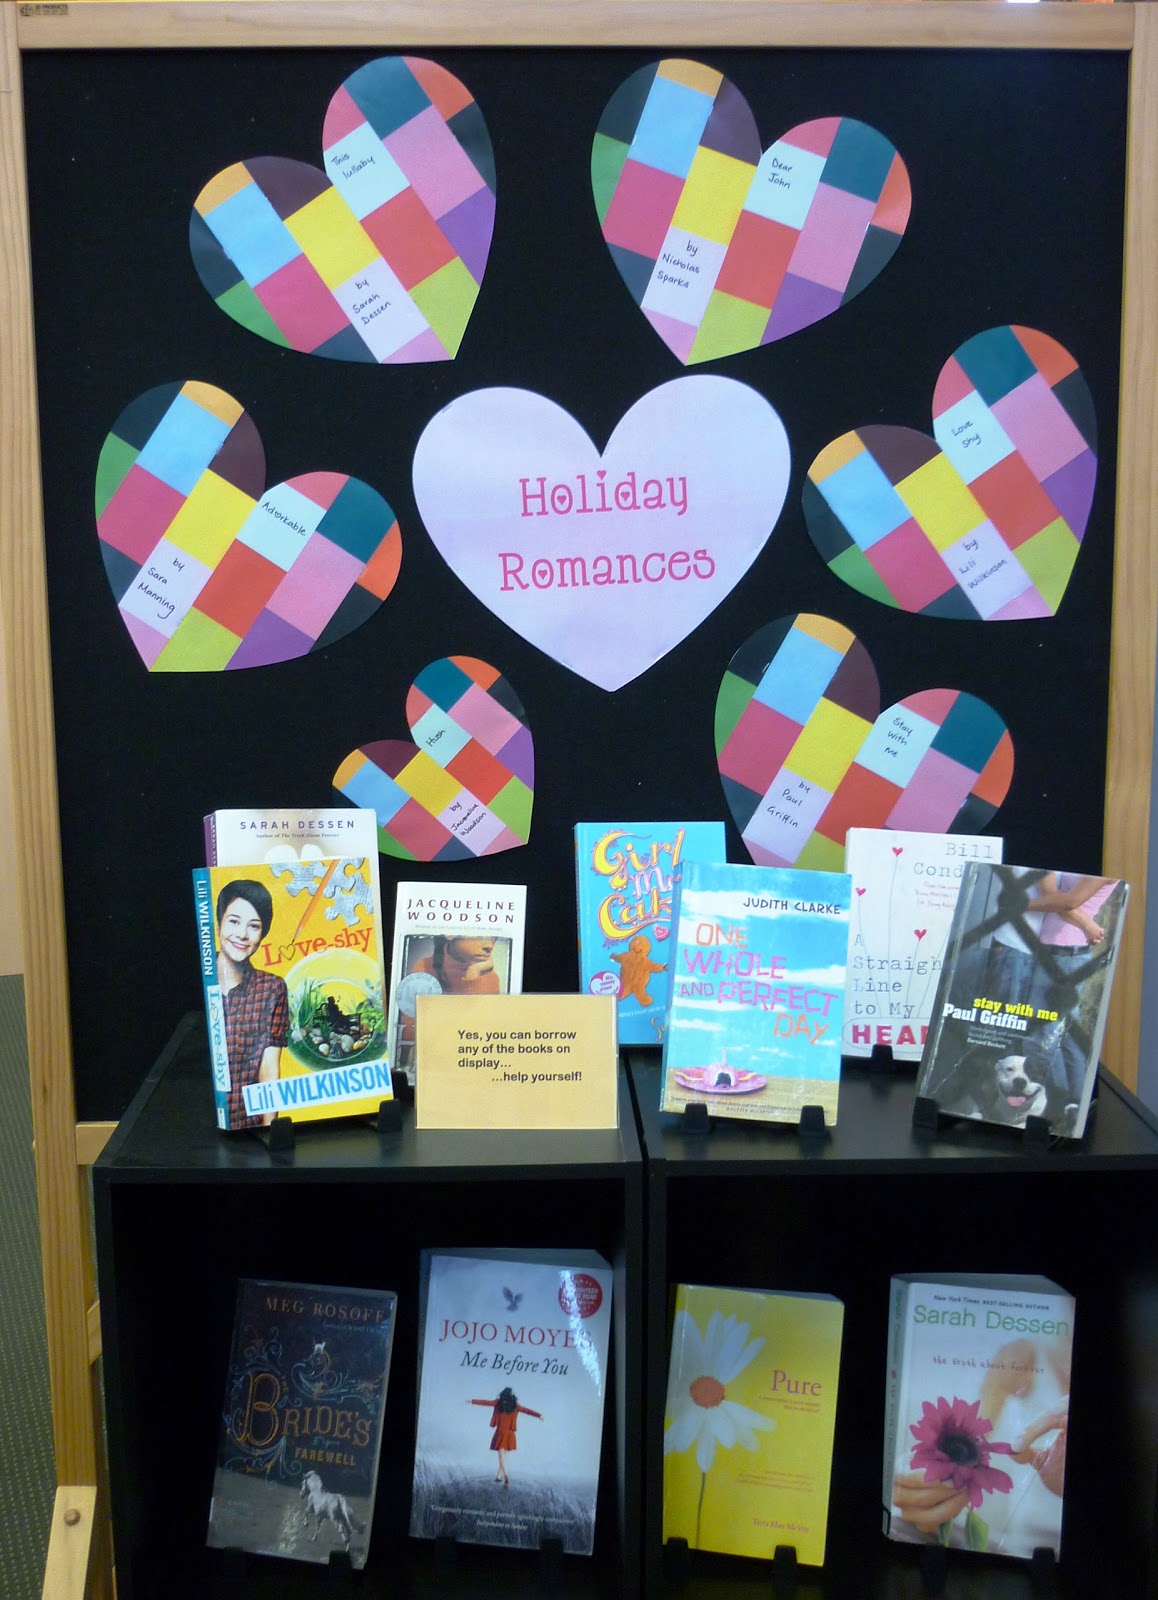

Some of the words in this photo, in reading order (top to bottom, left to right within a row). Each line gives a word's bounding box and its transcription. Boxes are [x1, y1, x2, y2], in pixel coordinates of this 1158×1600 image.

[331, 152, 350, 166] This
[771, 157, 793, 172] Dear
[768, 172, 791, 189] John
[686, 240, 699, 257] by
[662, 253, 700, 274] Nicholas
[355, 278, 369, 290] by
[657, 271, 690, 289] Sparks
[352, 294, 380, 314] Sarah
[361, 301, 391, 326] Dessen
[952, 420, 973, 437] Love
[519, 470, 688, 517] Holiday
[261, 502, 306, 536] Adorkable
[963, 538, 979, 552] by
[172, 558, 186, 571] by
[498, 549, 716, 591] Romances
[959, 559, 977, 575] Lili
[968, 559, 1008, 589] Wilkinson
[148, 567, 168, 584] Sara
[137, 581, 176, 619] Manning
[893, 717, 914, 737] Stay
[887, 730, 908, 746] with
[884, 747, 898, 758] me
[798, 781, 811, 794] by
[450, 802, 463, 812] by
[782, 788, 803, 807] Paul
[240, 821, 289, 830] SARAH
[298, 820, 355, 829] DESSEN
[460, 812, 487, 836] Woodson
[767, 806, 798, 828] Griffin
[591, 827, 686, 890] Girl
[945, 842, 994, 859] Bill
[913, 862, 963, 879] Cond
[196, 879, 207, 899] Lili
[407, 899, 515, 911] JACQUELINE
[598, 888, 672, 940] Cak
[743, 897, 788, 911] JUDITH
[794, 901, 841, 915] CLARKE
[407, 911, 514, 924] WOODSON
[198, 900, 214, 976] WILKINSON
[696, 923, 748, 949] ONE
[854, 933, 865, 947] A
[683, 949, 787, 980] WHOLE
[853, 955, 942, 976] Straigh
[853, 978, 903, 993] Line
[680, 982, 714, 997] AND
[717, 980, 839, 1017] PERFECT
[853, 1000, 876, 1016] to
[889, 1002, 916, 1018] My
[942, 1003, 977, 1022] Paul
[980, 1011, 1028, 1031] Griffin
[973, 997, 1002, 1013] stay
[1005, 1002, 1034, 1018] with
[1037, 1008, 1059, 1021] me
[457, 1029, 483, 1042] Yes,
[486, 1032, 507, 1042] you
[510, 1032, 531, 1040] can
[534, 1030, 577, 1040] borrow
[773, 1012, 829, 1045] DAY
[458, 1045, 477, 1056] any
[482, 1044, 494, 1054] of
[496, 1044, 515, 1054] the
[518, 1044, 553, 1054] books
[556, 1046, 571, 1054] on
[458, 1057, 512, 1070] display...
[491, 1071, 529, 1083] ...help
[531, 1071, 582, 1083] yourself!
[246, 1085, 275, 1113] Lili
[277, 1062, 391, 1104] WILKINSON
[265, 1297, 305, 1315] MEG
[313, 1302, 386, 1324] ROSOFF
[913, 1304, 976, 1327] Sarah
[986, 1311, 1069, 1336] Dessen
[438, 1319, 498, 1345] JOJO
[504, 1325, 593, 1349] MOYES
[460, 1351, 487, 1368] Me
[491, 1353, 540, 1375] Before
[541, 1358, 569, 1376] You
[933, 1354, 947, 1365] the
[952, 1356, 976, 1369] truth
[770, 1369, 822, 1397] Pure
[236, 1373, 373, 1448] BRIDE'S
[294, 1447, 357, 1467] FAREWELL
